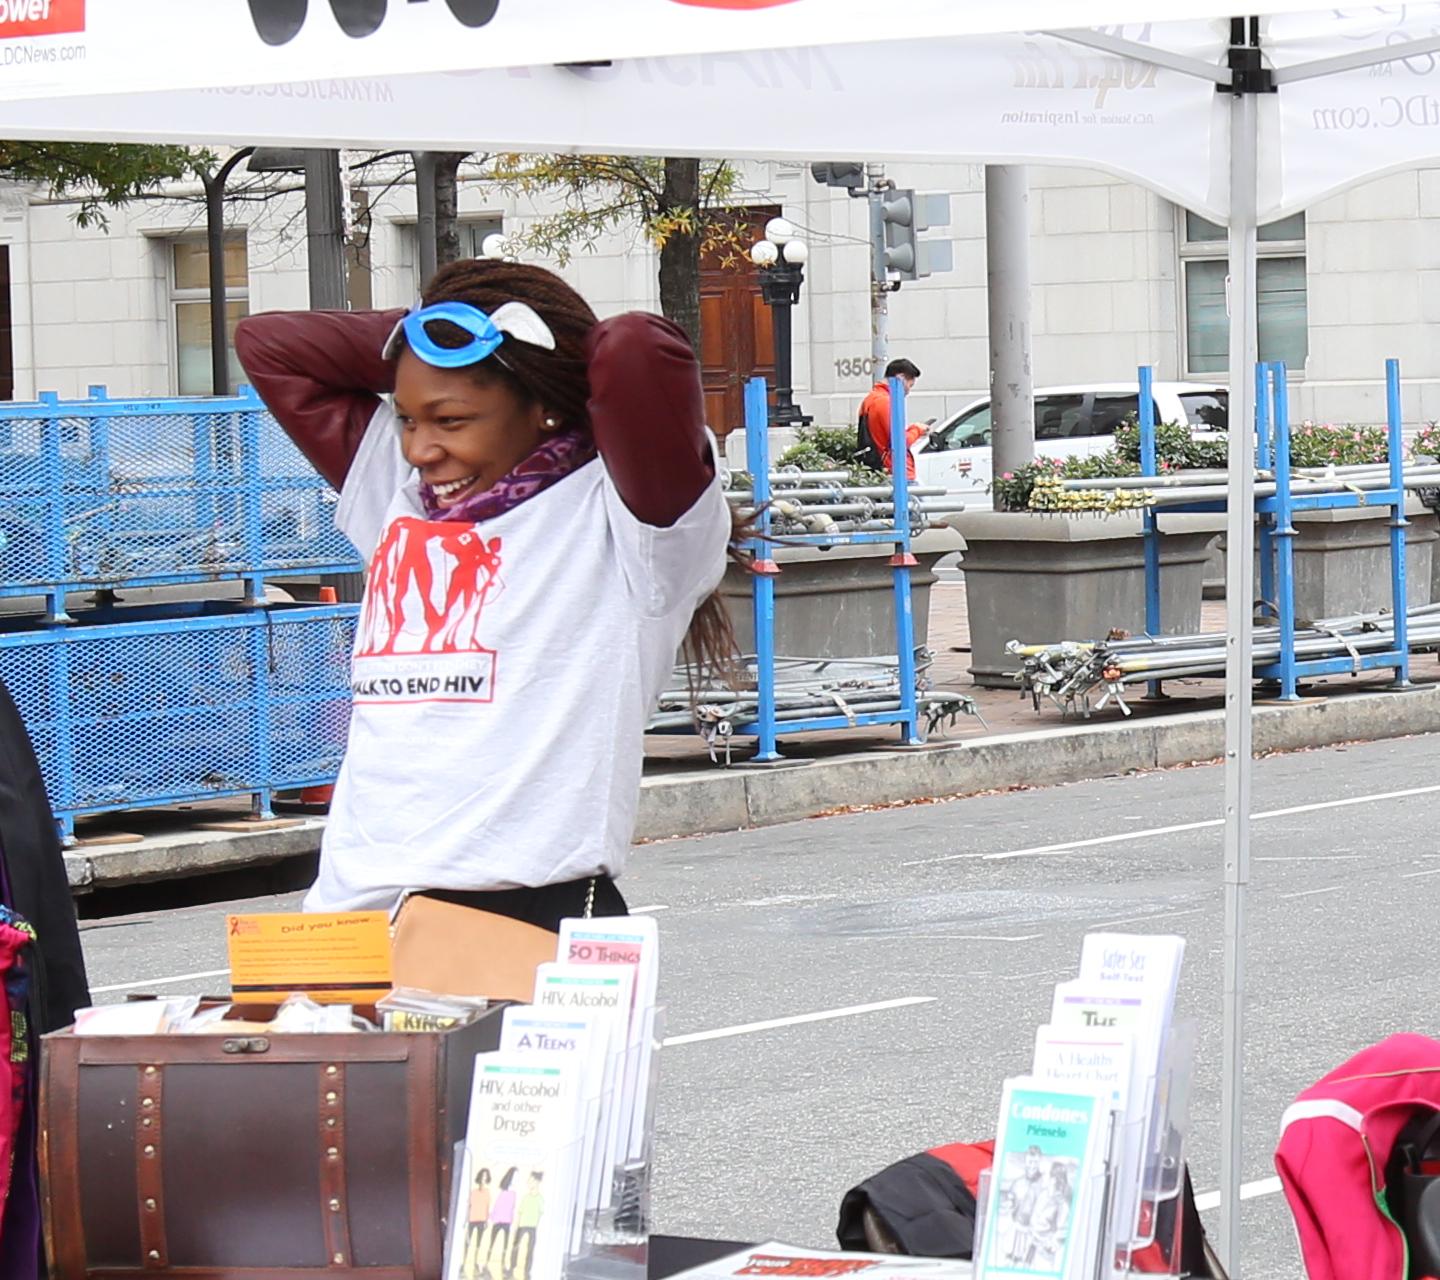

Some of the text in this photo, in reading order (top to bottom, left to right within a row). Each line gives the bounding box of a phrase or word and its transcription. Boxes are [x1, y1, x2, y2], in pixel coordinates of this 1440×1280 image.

[834, 357, 872, 377] 1350
[381, 679, 403, 695] TO
[407, 677, 441, 695] END
[444, 675, 485, 694] HIV
[568, 944, 592, 961] 50
[541, 989, 619, 1009] HIV, Alcohol
[517, 1032, 532, 1049] A
[479, 1078, 561, 1098] HIV, Alcohol
[491, 1100, 543, 1113] and other
[1010, 1099, 1090, 1126] Condones
[493, 1114, 536, 1137] Drugs
